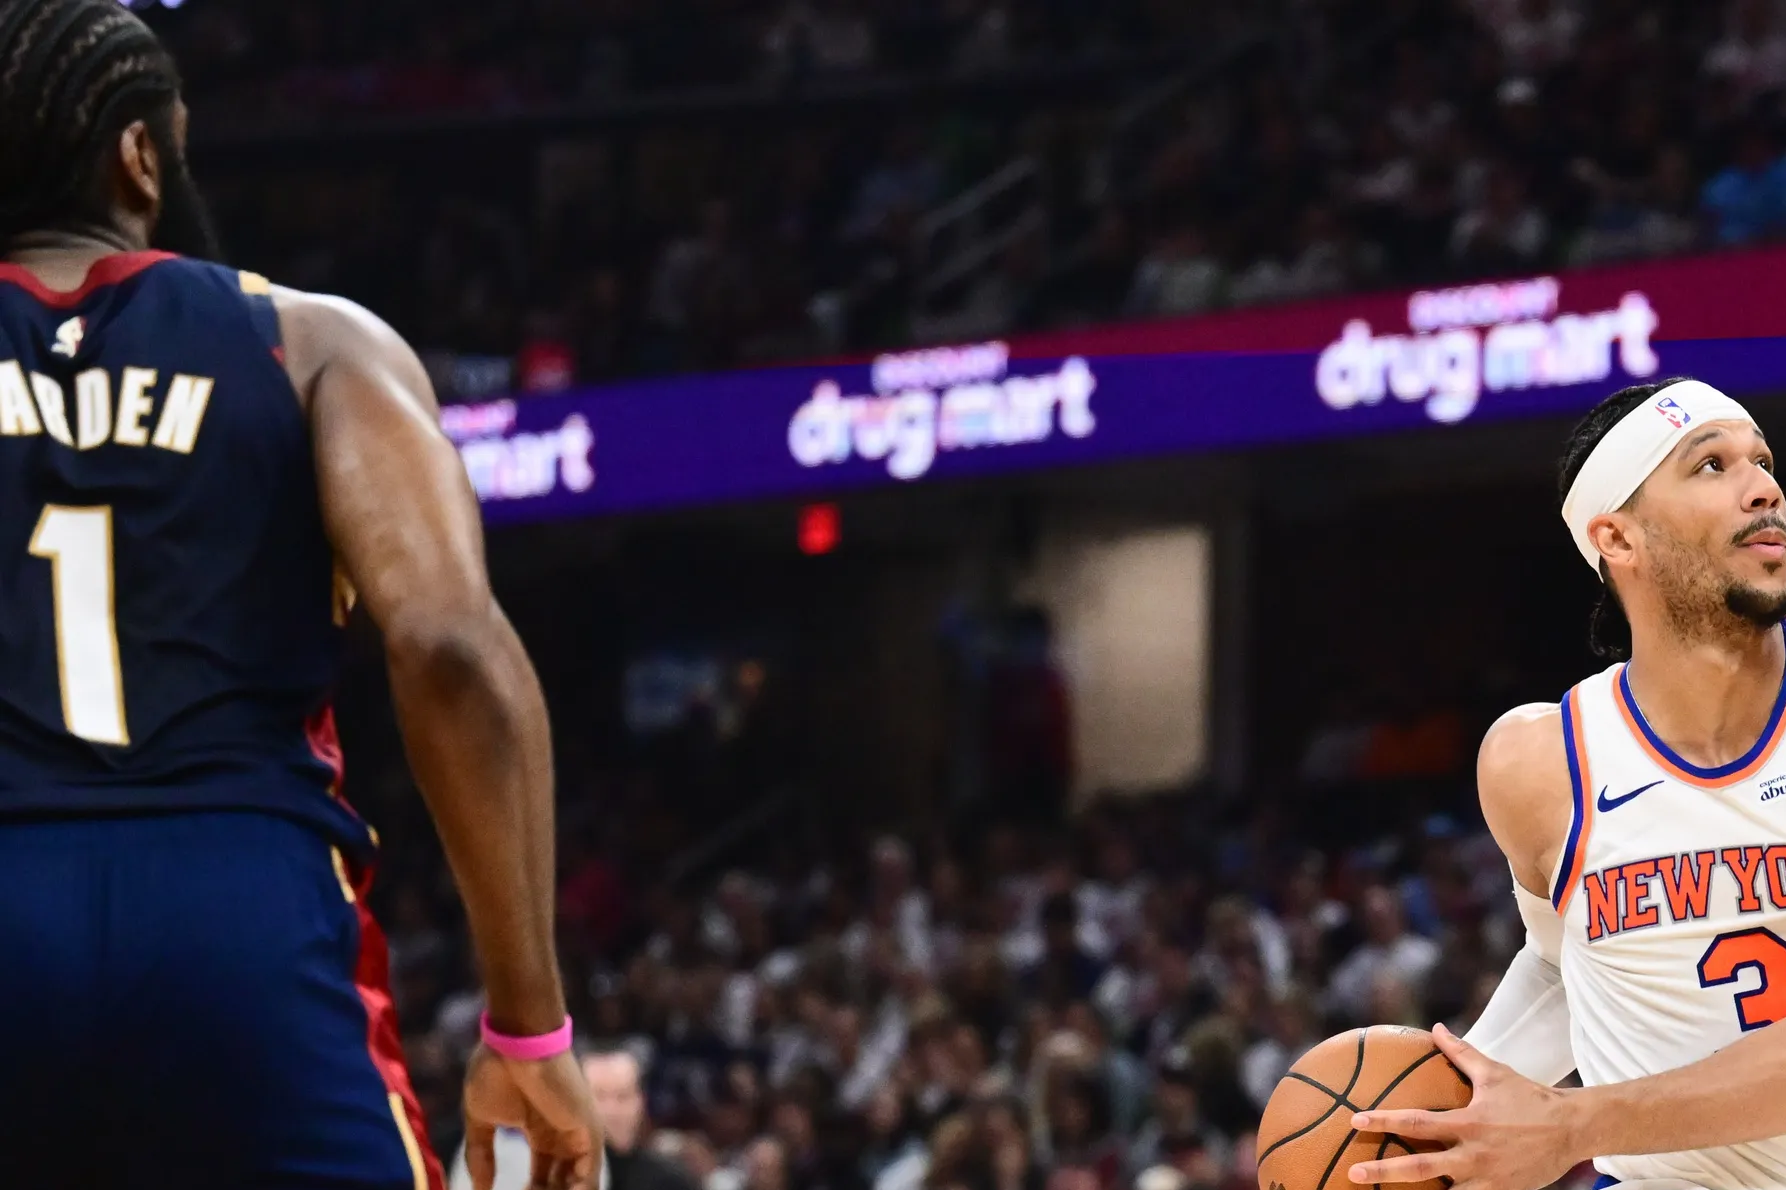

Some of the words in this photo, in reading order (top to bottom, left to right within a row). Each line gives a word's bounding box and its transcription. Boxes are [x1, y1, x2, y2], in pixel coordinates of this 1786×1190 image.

[1317, 320, 1480, 422] drug
[28, 503, 131, 746] 1
[1582, 849, 1717, 944] NEW
